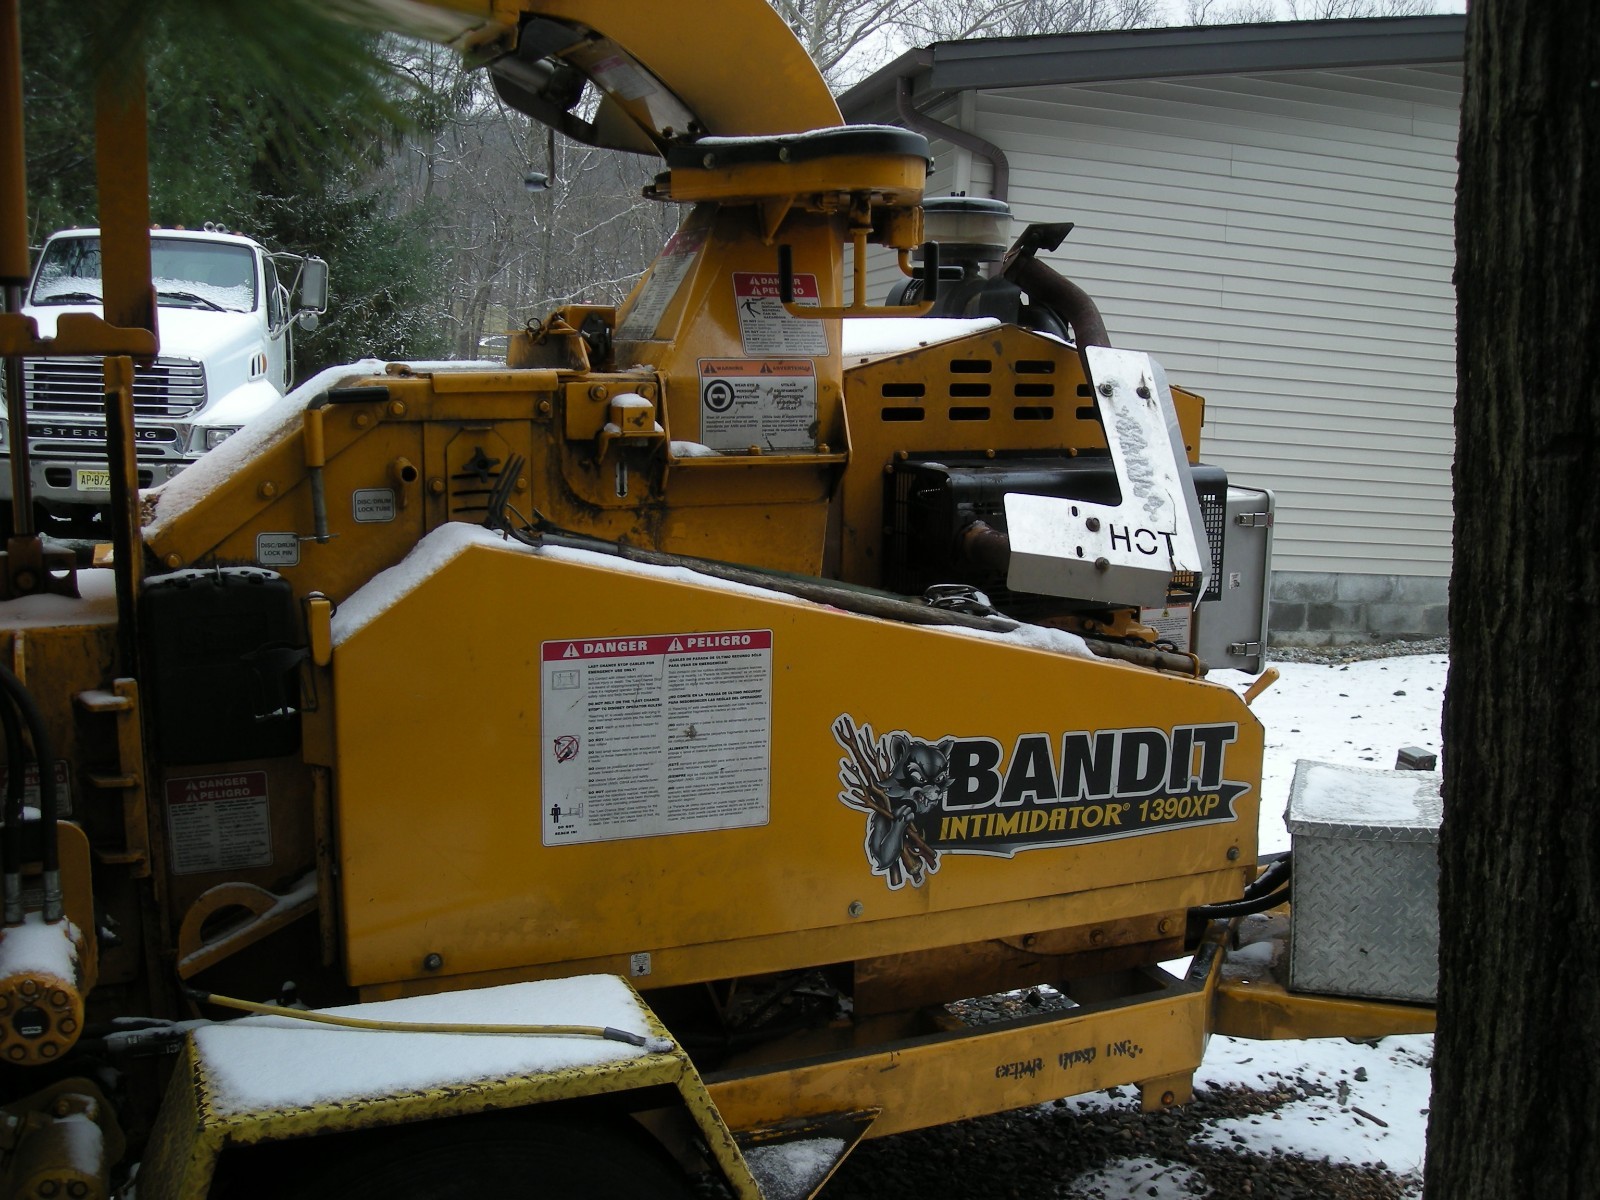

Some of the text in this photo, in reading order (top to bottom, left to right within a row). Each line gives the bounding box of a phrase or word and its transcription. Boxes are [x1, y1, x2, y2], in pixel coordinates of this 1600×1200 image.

[762, 287, 804, 295] PELRO
[43, 427, 157, 438] STERNG
[1109, 523, 1177, 557] HOT
[583, 640, 648, 654] DANGER
[687, 635, 751, 648] PELIGRO
[944, 724, 1237, 809] BANDIT
[199, 777, 248, 788] DANGER
[200, 788, 250, 800] PELIGRO
[1138, 794, 1220, 823] 1390XP
